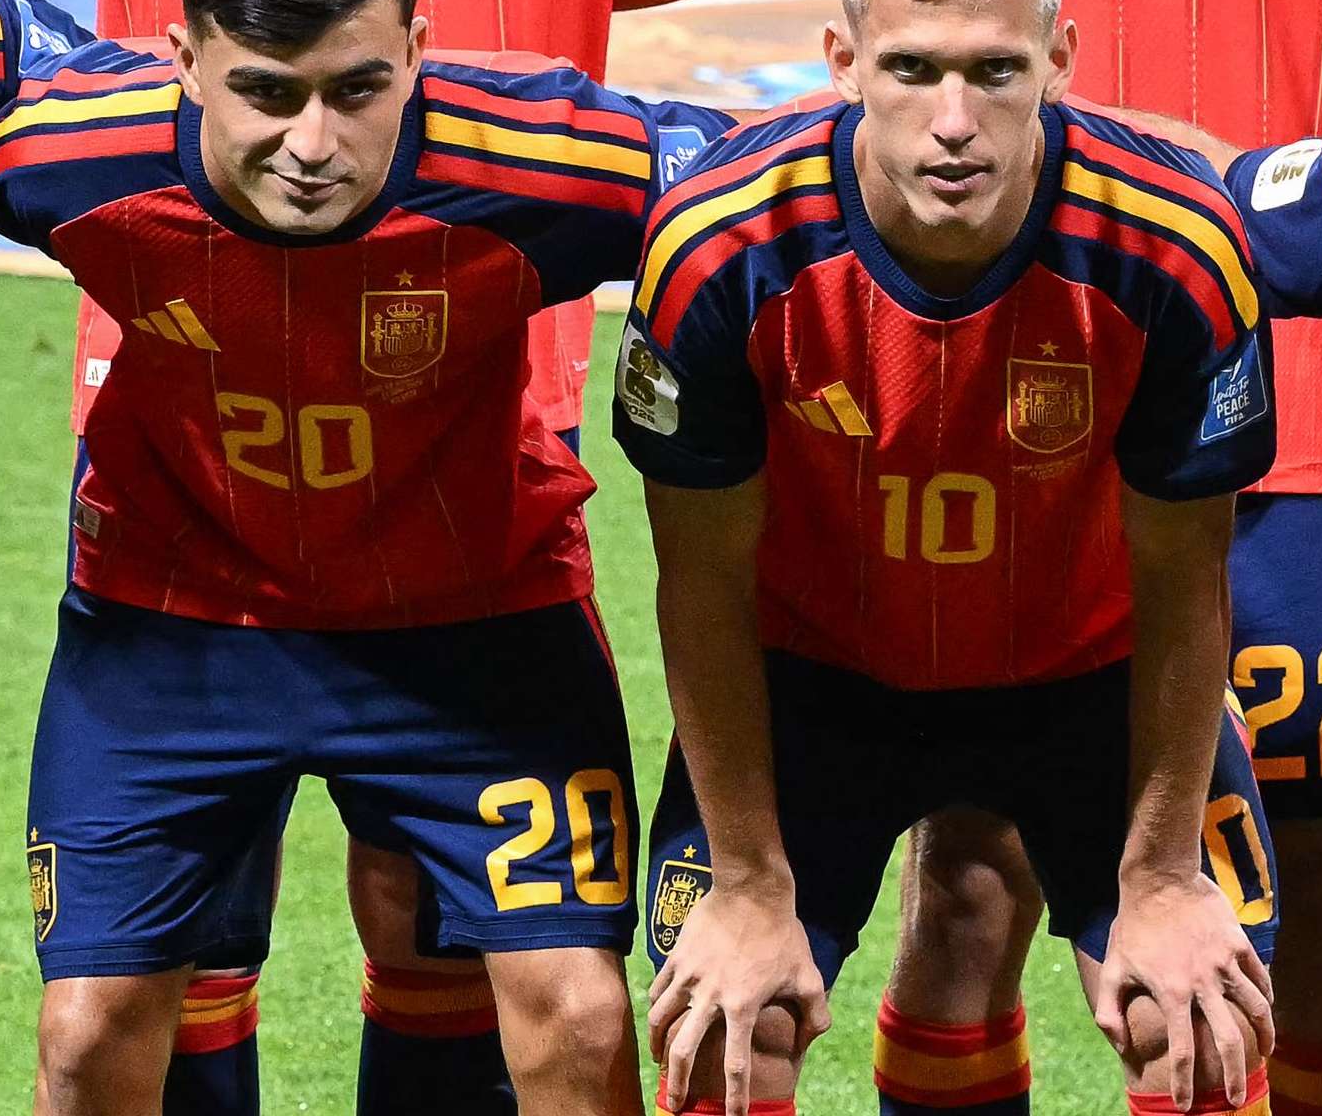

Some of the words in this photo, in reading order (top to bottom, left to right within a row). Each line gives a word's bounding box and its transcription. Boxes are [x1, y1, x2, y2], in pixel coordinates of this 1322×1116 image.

[217, 391, 374, 490] 20
[1216, 391, 1251, 419] PEACE
[877, 472, 998, 565] 10
[477, 768, 631, 912] 20
